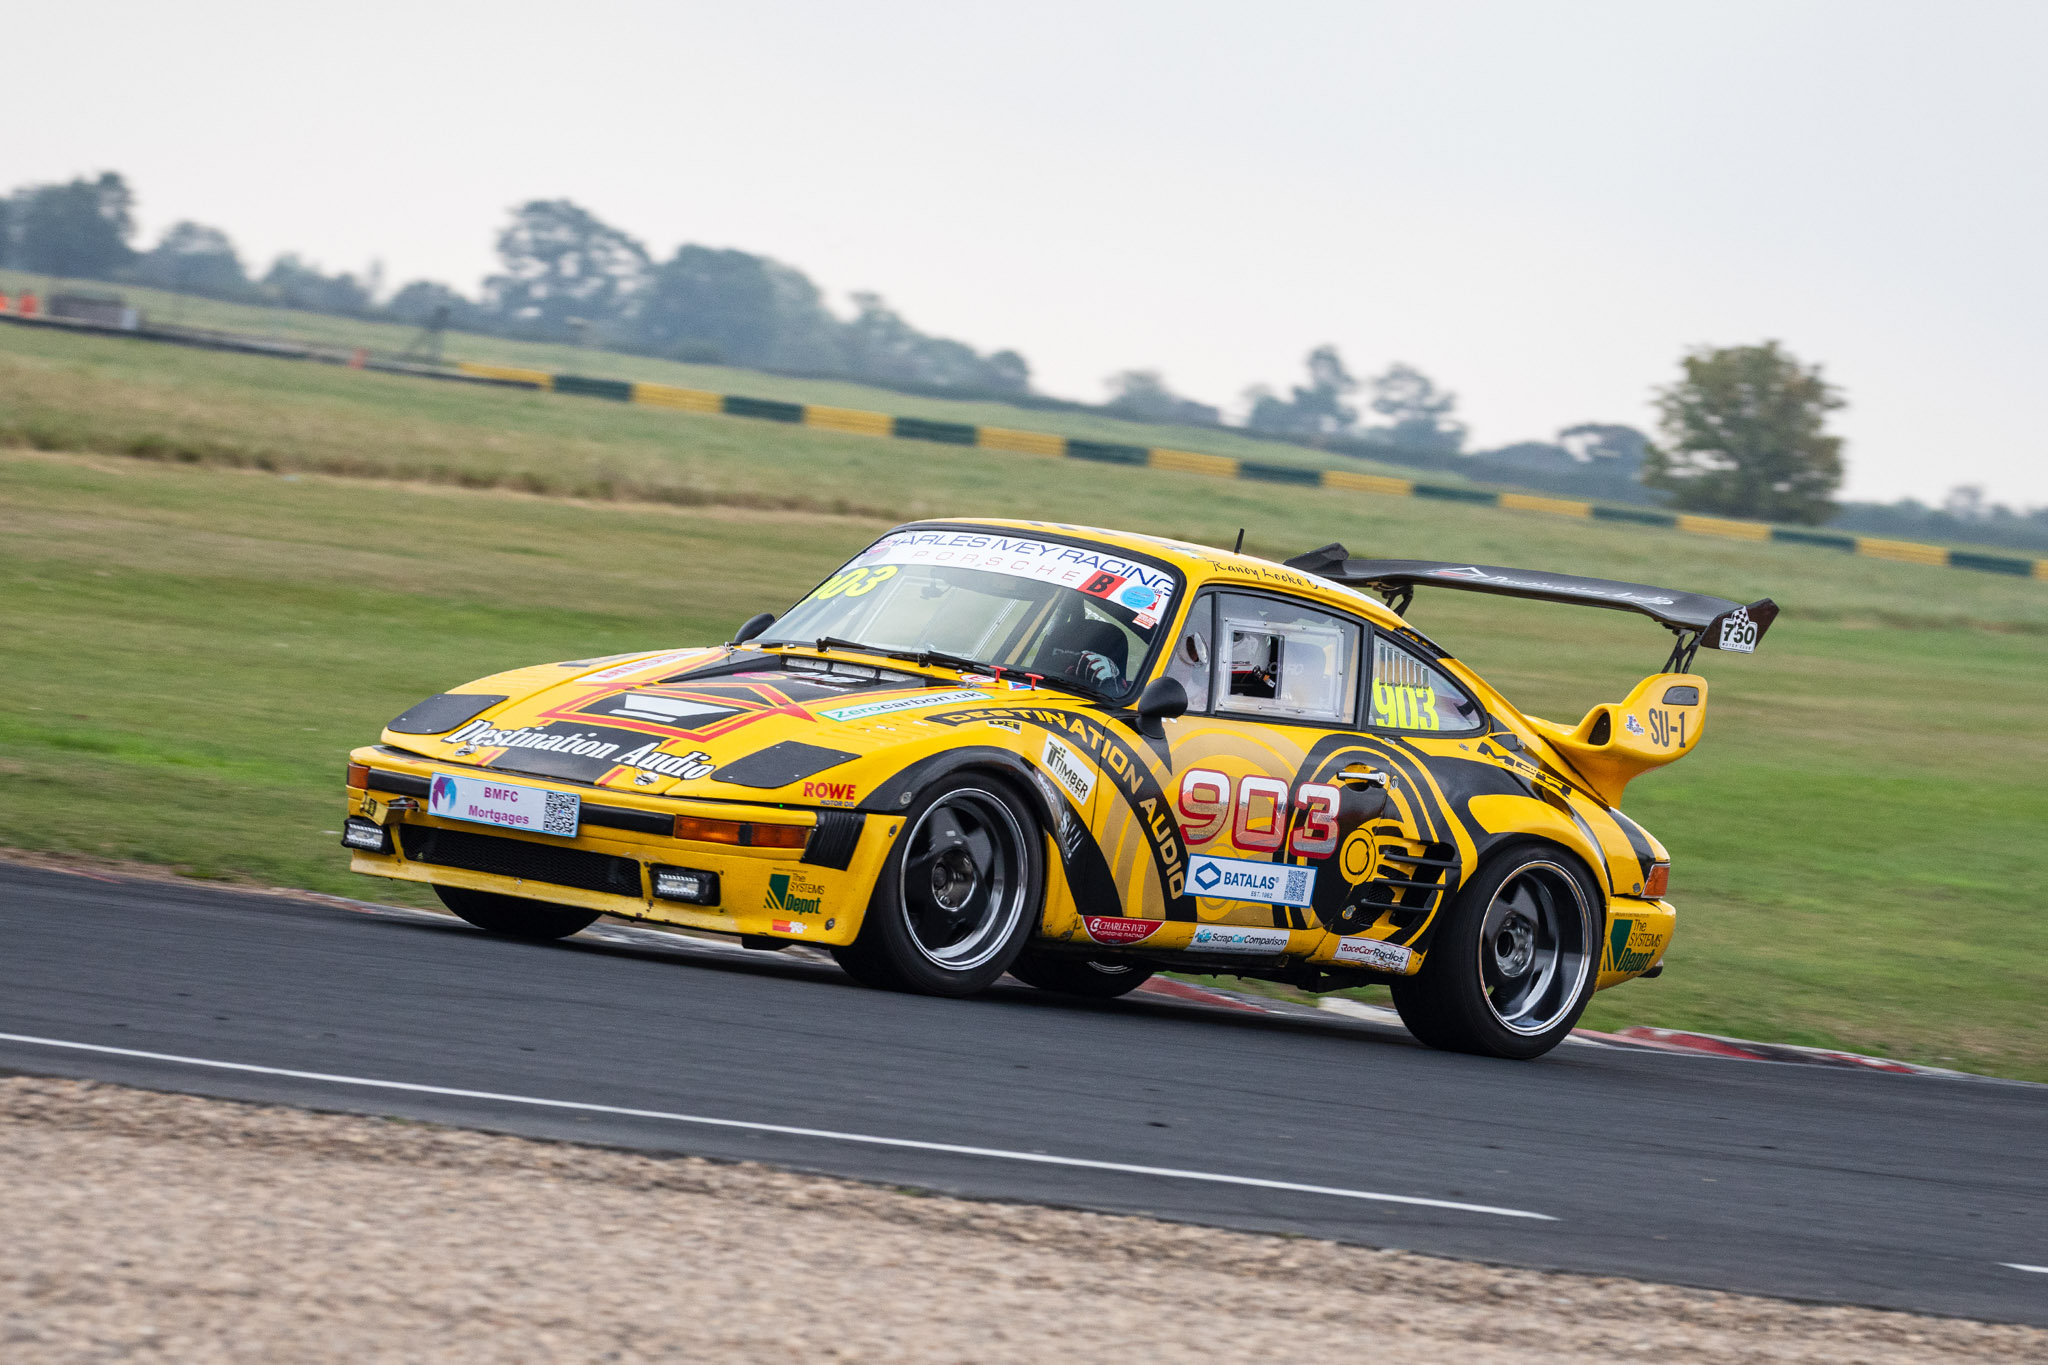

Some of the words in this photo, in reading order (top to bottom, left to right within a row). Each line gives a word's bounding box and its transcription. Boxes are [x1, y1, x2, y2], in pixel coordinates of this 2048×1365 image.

[889, 534, 990, 548] HARLES
[990, 538, 1062, 557] IVEY
[1057, 549, 1175, 597] RACING
[911, 550, 1081, 582] PORSCHE
[1086, 574, 1115, 593] B
[1723, 623, 1756, 645] 750
[832, 689, 982, 719] Zerocarbon.uk
[1372, 677, 1440, 731] 903
[1648, 707, 1686, 749] SU-1
[443, 718, 621, 760] Destination
[611, 741, 716, 780] Audio
[1053, 753, 1089, 798] TIMBER
[483, 786, 519, 803] BMFC
[803, 782, 856, 800] ROWE
[467, 804, 530, 826] Mortgages
[943, 708, 1145, 795] DESTINATION
[1138, 797, 1185, 900] AUDIO
[1178, 768, 1341, 860] 903
[792, 872, 806, 883] The
[789, 882, 825, 896] SYSTEMS
[785, 893, 823, 915] Depot
[1098, 920, 1132, 932] CHARLES
[1131, 923, 1149, 933] IVEY
[1634, 918, 1647, 932] The
[1211, 932, 1288, 947] ScrapCarComparison
[1628, 932, 1663, 948] SYSTEMS
[1340, 943, 1405, 963] RaceCarRadios
[1616, 947, 1655, 975] Depot
